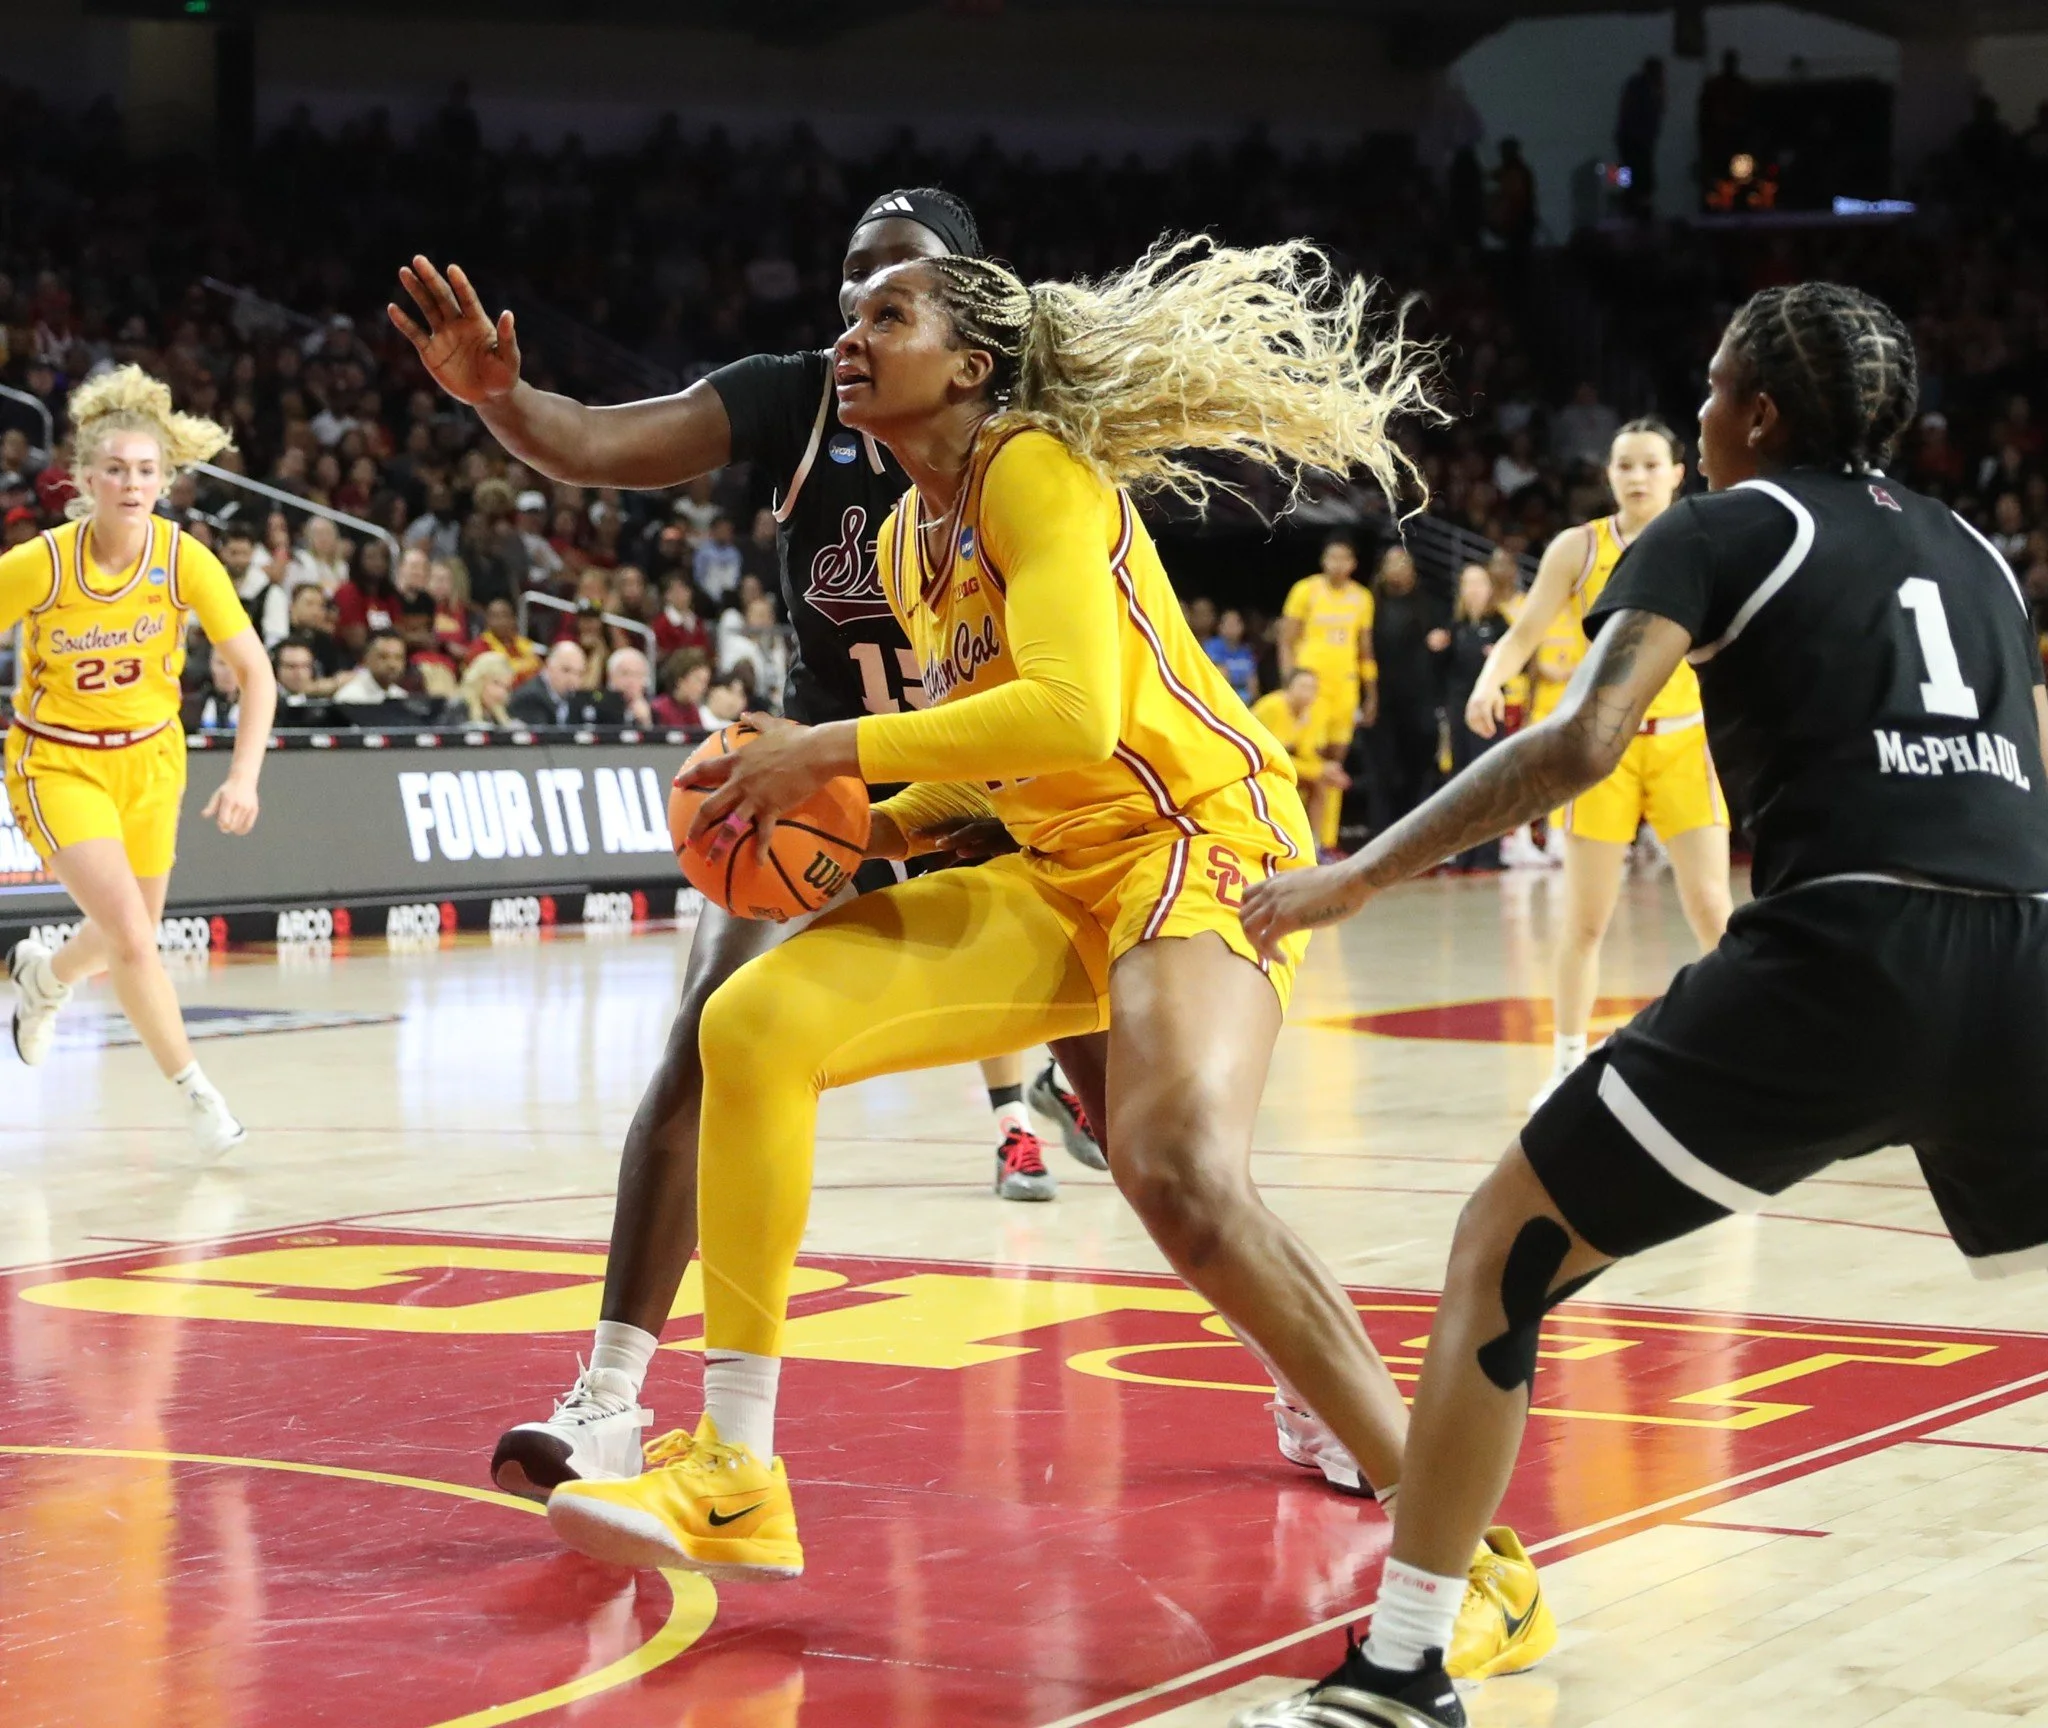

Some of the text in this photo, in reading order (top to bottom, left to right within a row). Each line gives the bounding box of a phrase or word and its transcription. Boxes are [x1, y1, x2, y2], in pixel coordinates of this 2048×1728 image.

[51, 613, 165, 655] Southern Cal
[953, 613, 1000, 684] Cal
[1897, 577, 1980, 720] 1
[75, 657, 143, 692] 23
[1873, 729, 2031, 792] McPHAUL
[398, 767, 676, 862] FOUR IT ALL
[277, 907, 333, 942] ARCO
[386, 903, 441, 936] ARCO
[489, 896, 541, 929] ARCO
[582, 891, 634, 922] ARCO
